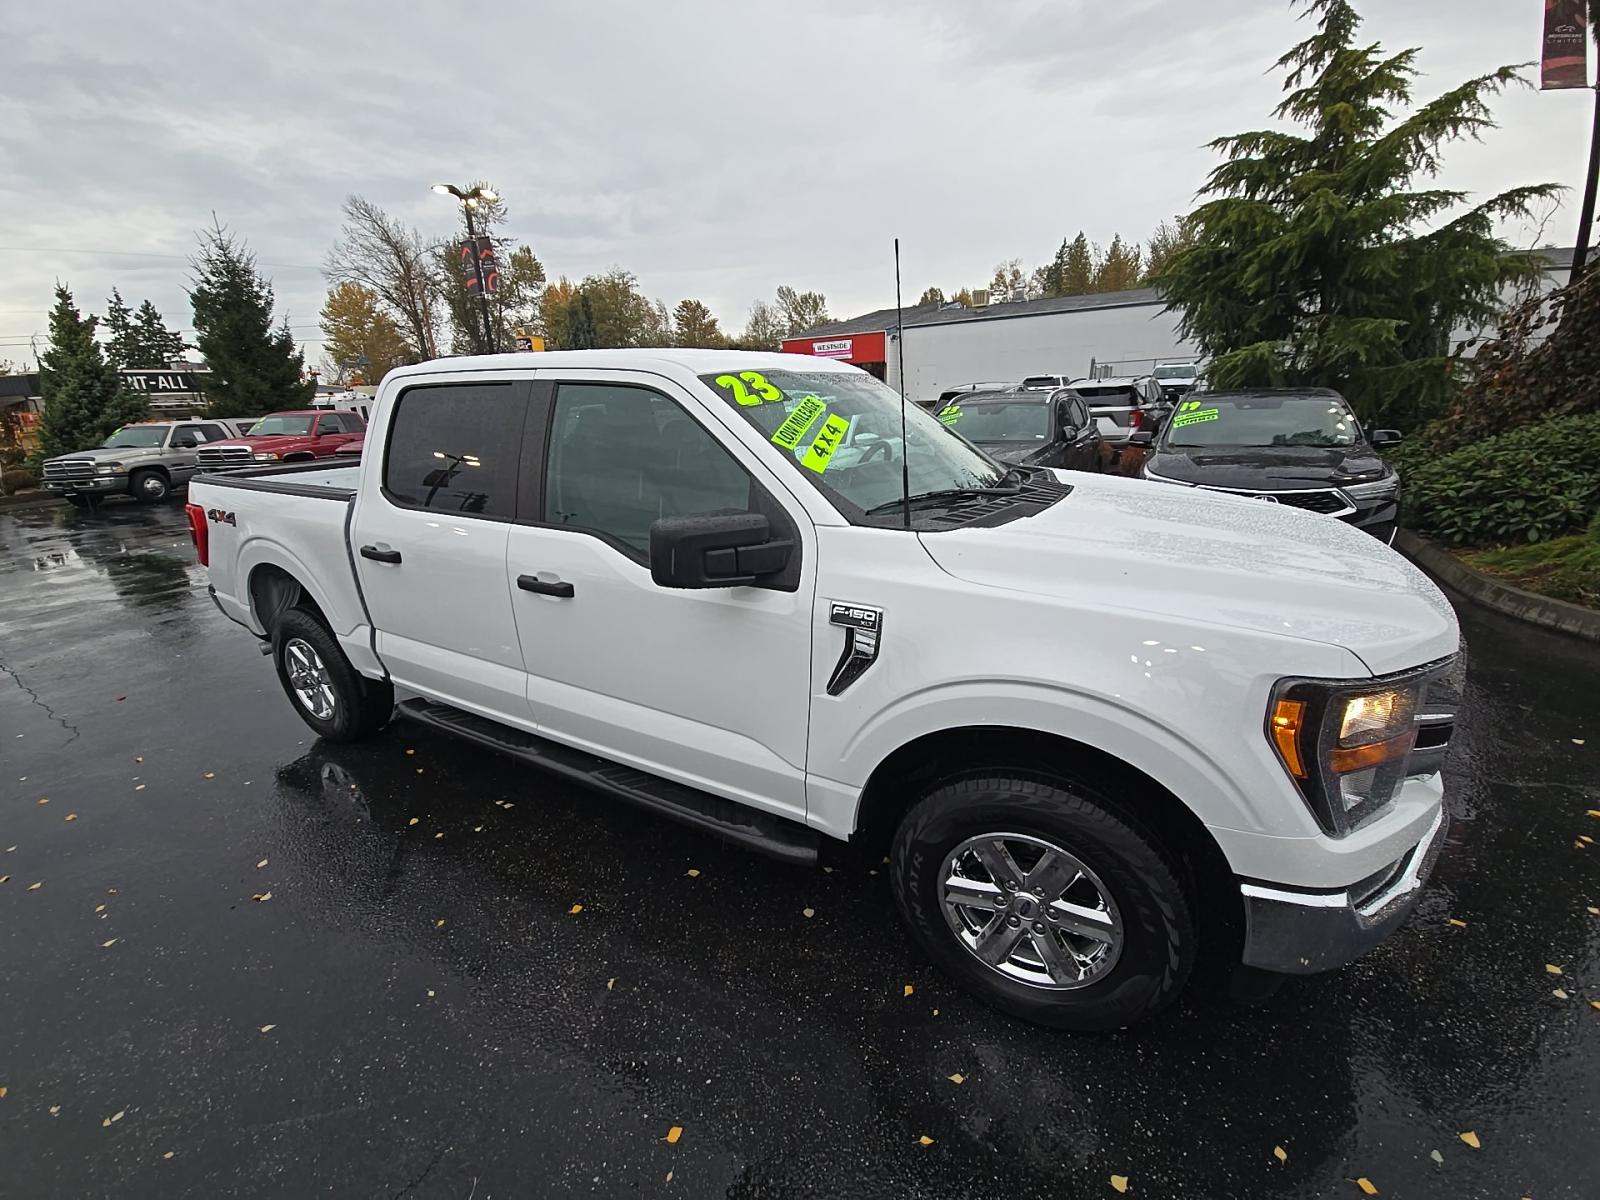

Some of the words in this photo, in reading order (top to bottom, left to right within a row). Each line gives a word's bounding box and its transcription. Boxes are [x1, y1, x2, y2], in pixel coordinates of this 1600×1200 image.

[816, 342, 849, 351] WESTSIDE
[715, 371, 781, 406] 23
[776, 423, 800, 445] LOW
[789, 398, 820, 430] MILEAGE
[832, 606, 876, 621] F-150
